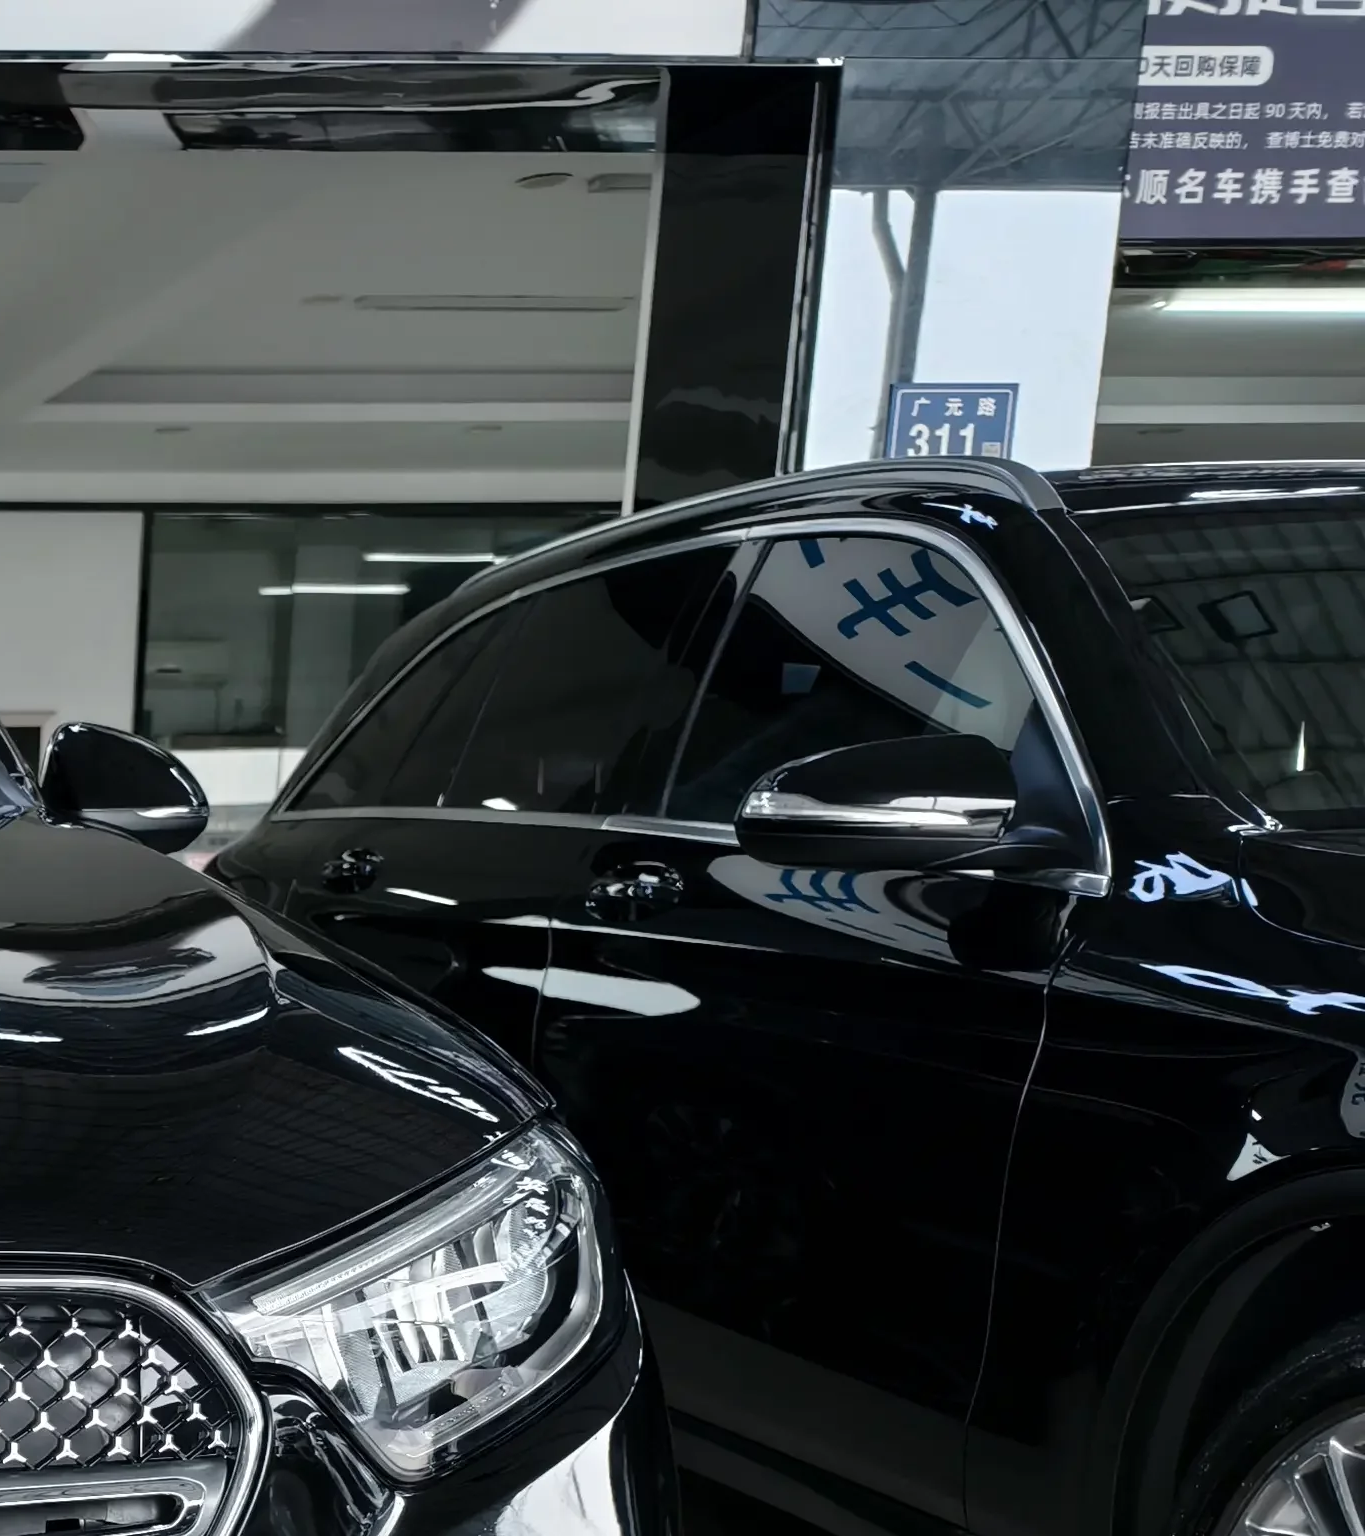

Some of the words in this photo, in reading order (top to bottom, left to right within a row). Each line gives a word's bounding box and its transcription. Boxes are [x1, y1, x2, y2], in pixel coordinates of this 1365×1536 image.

[1265, 104, 1286, 119] 90
[1124, 167, 1365, 205] 顺名车携手查
[911, 397, 996, 417] 广元路
[906, 423, 975, 456] 311
